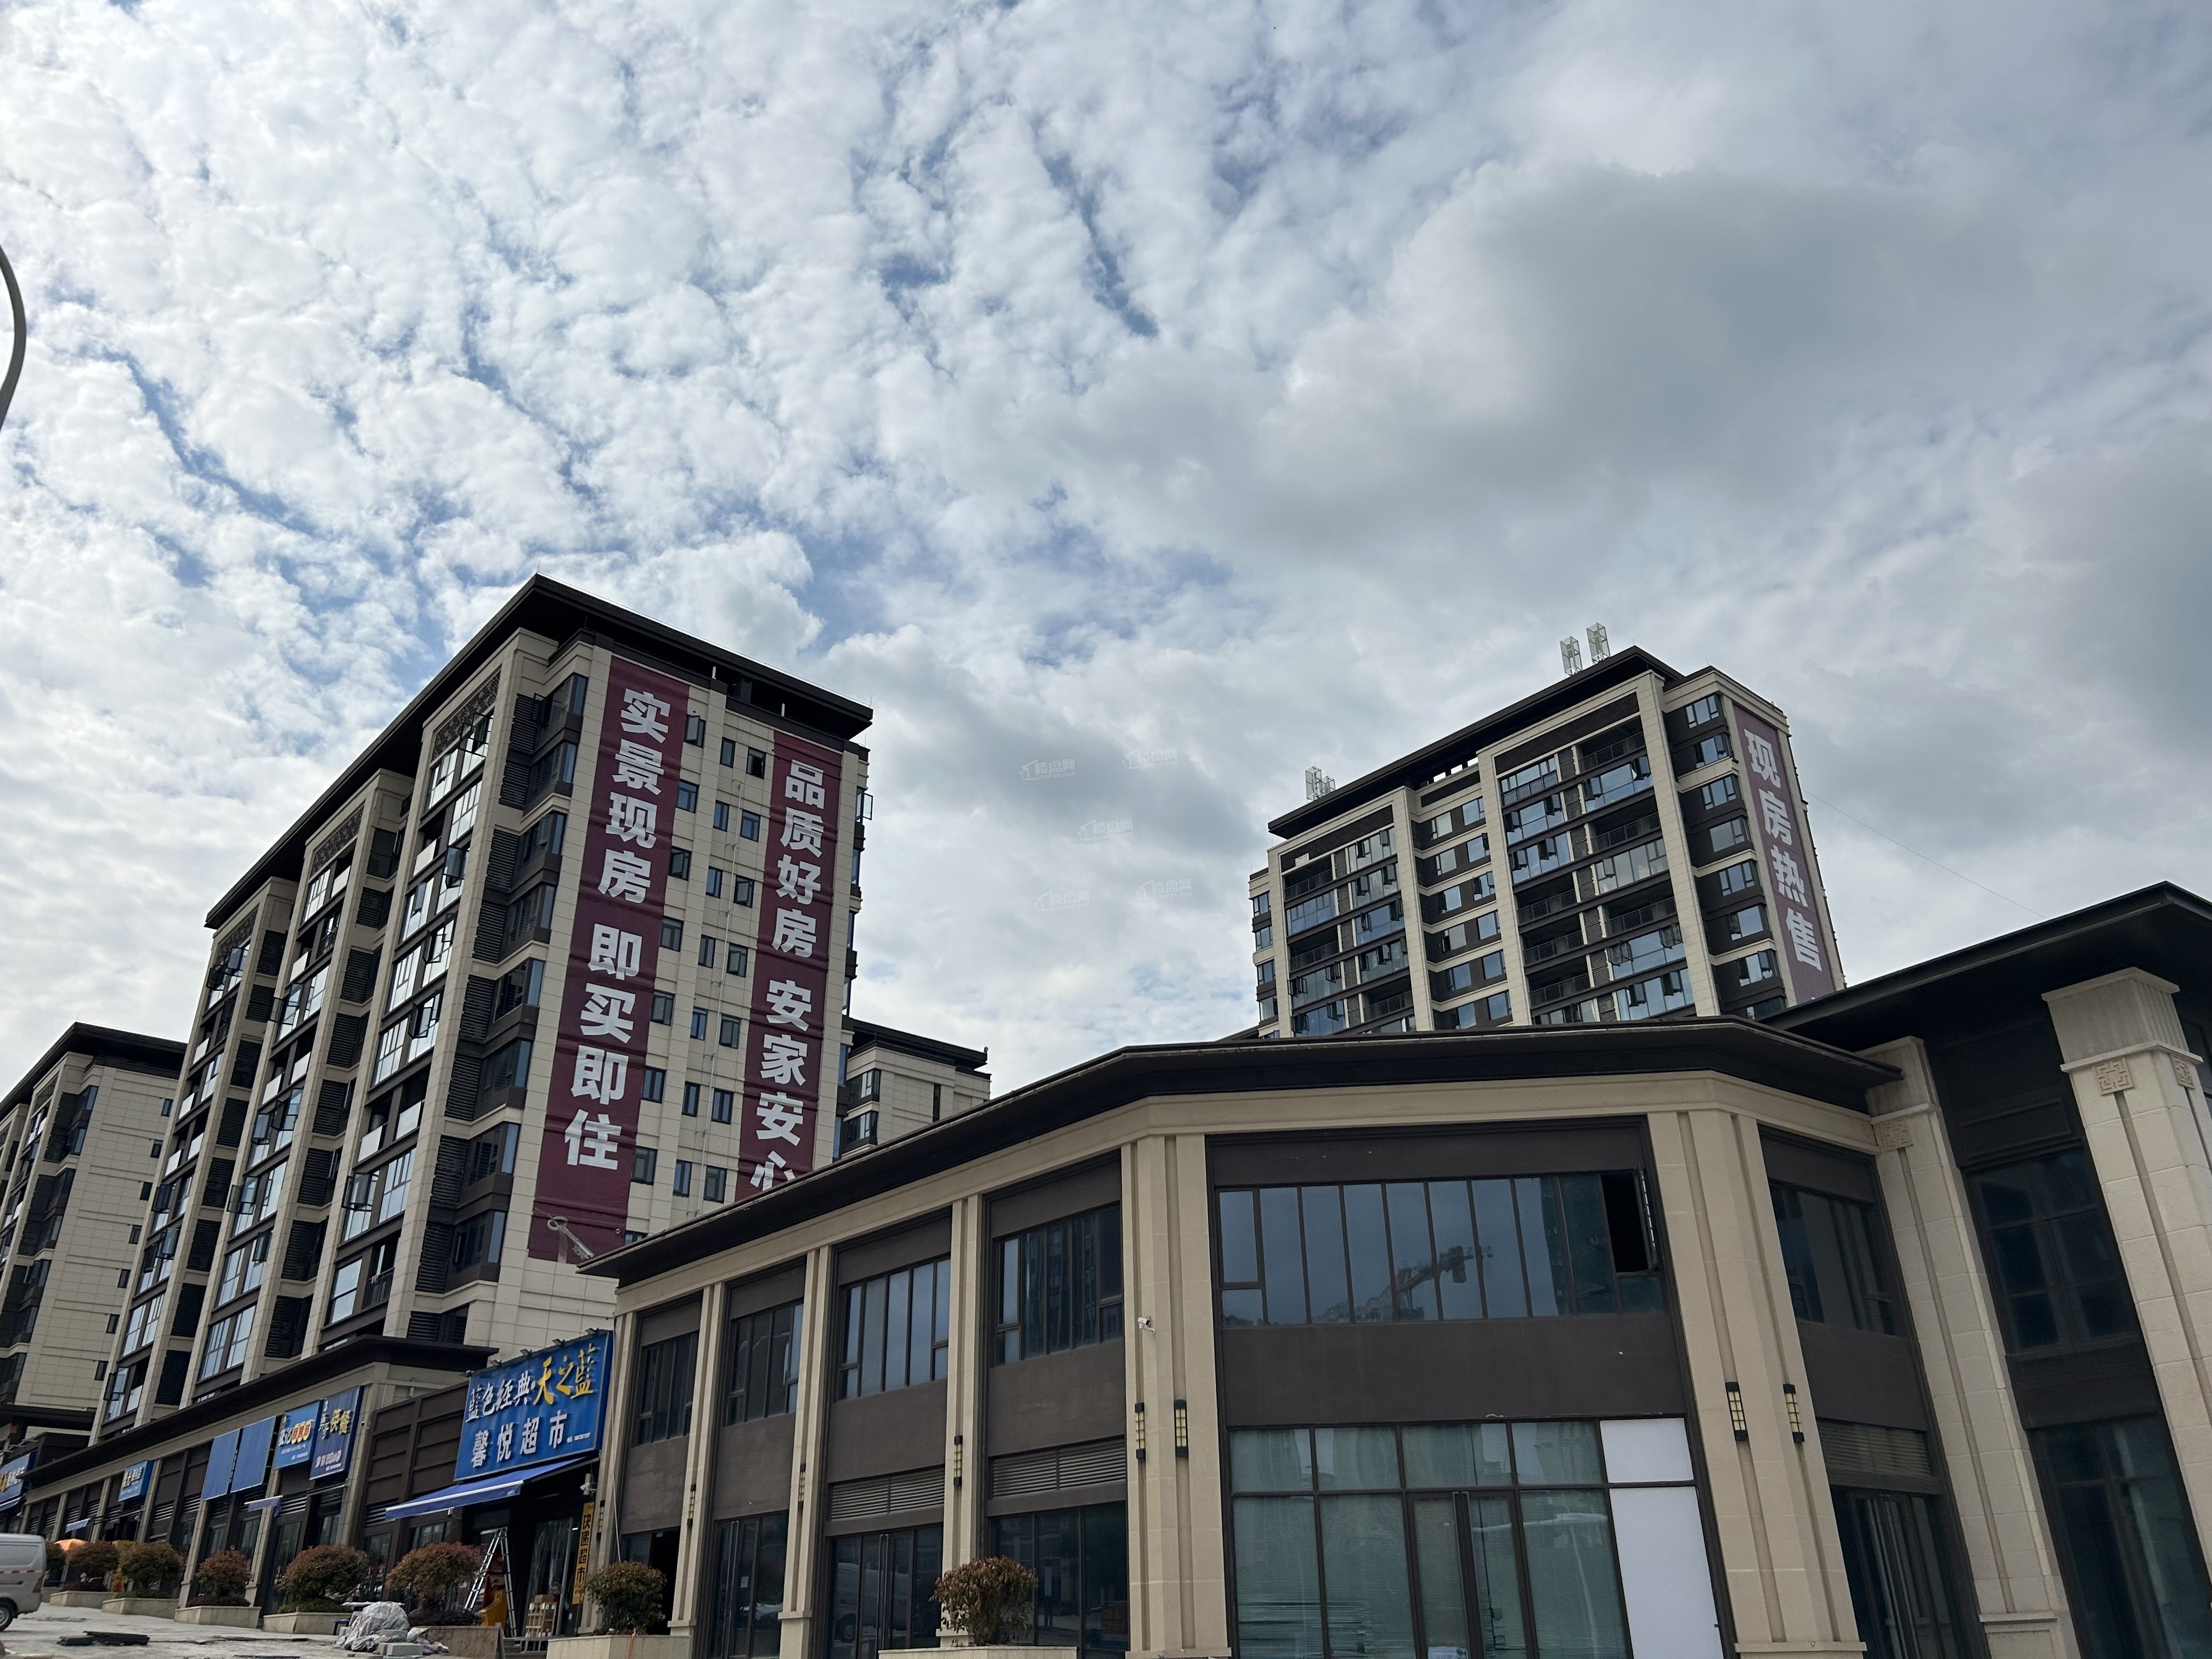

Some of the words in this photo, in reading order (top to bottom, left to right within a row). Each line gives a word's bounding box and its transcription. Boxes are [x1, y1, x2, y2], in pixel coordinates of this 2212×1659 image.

[597, 688, 671, 904] 实景现房
[771, 759, 825, 959] 品质好房
[1743, 729, 1822, 972] 现房热售
[564, 924, 642, 1170] 即买即住
[471, 1410, 568, 1468] 馨悦超市
